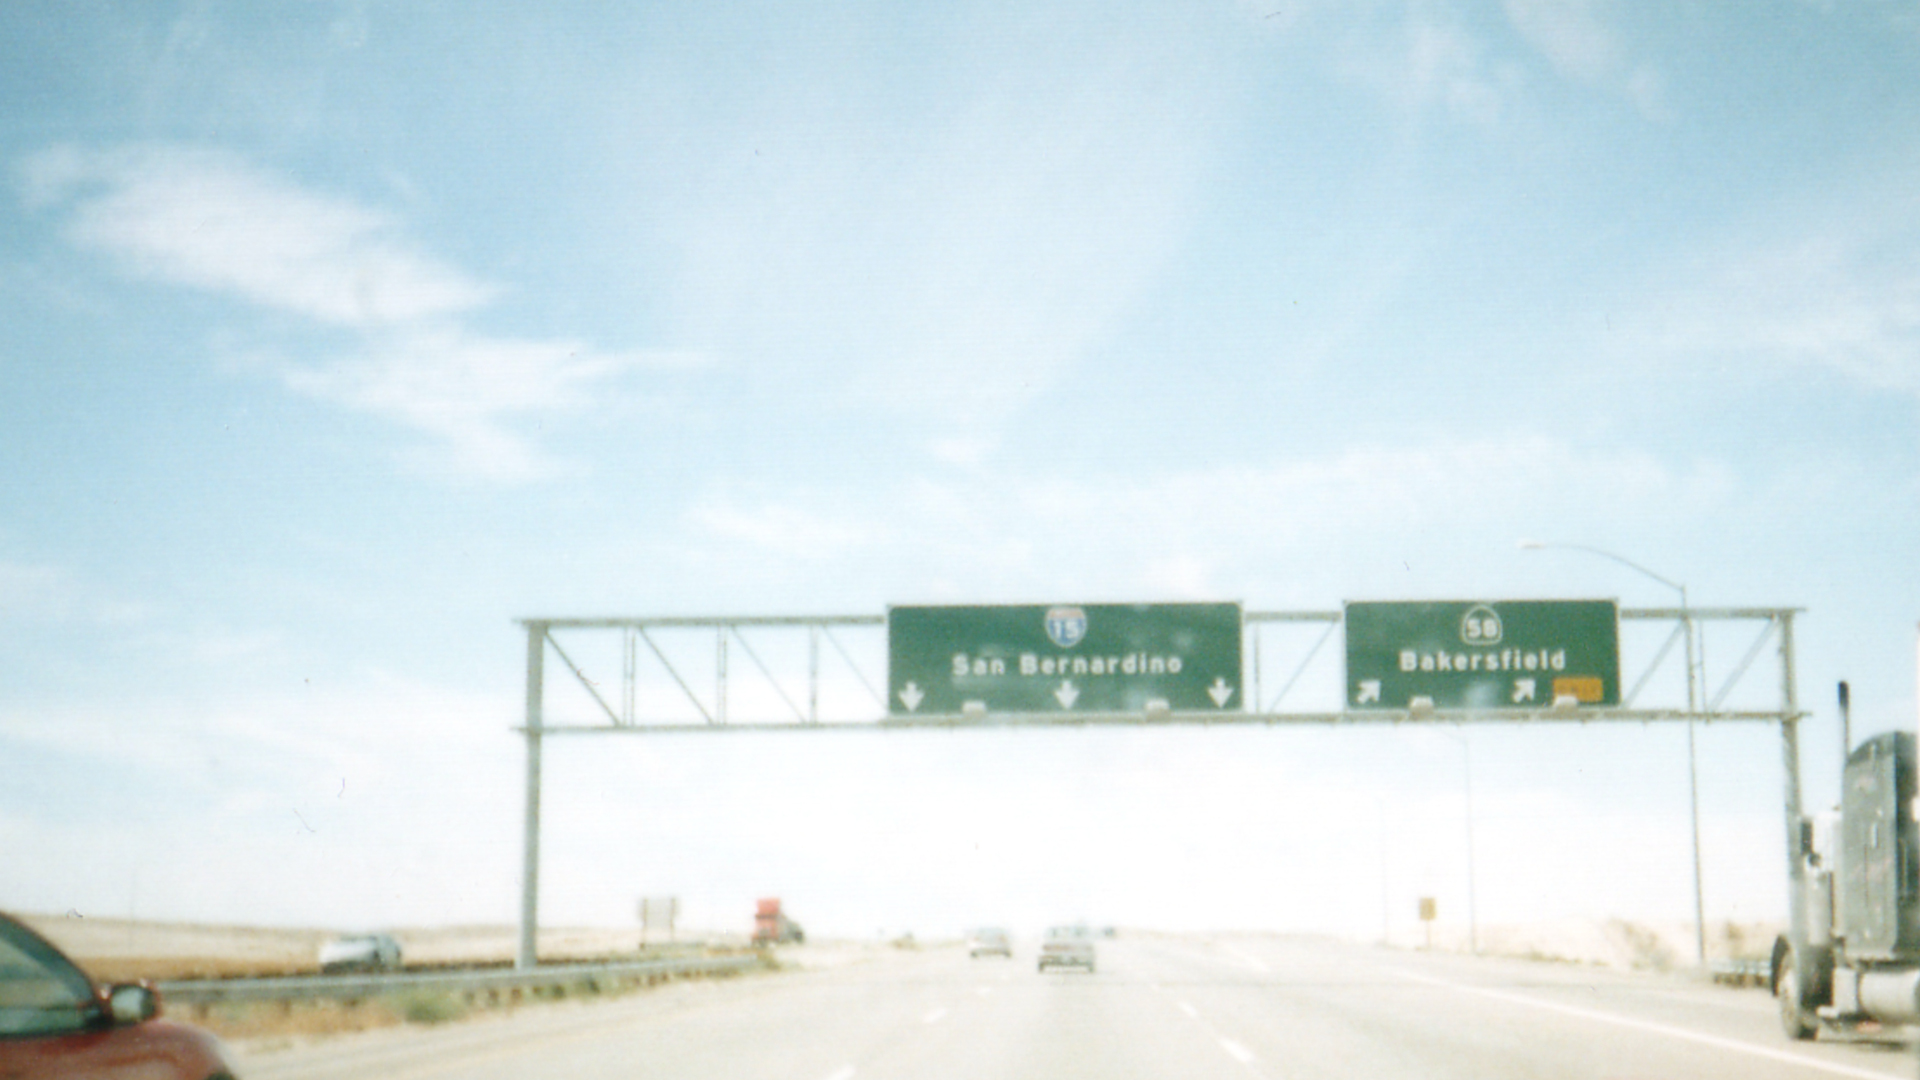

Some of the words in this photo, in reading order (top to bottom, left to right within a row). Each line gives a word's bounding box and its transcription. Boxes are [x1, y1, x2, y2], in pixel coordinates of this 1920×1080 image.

[1053, 620, 1081, 638] 15
[1467, 619, 1498, 637] 58
[952, 653, 1005, 676] San
[1019, 653, 1182, 675] Bernardino
[1399, 650, 1566, 671] Bakersfield
